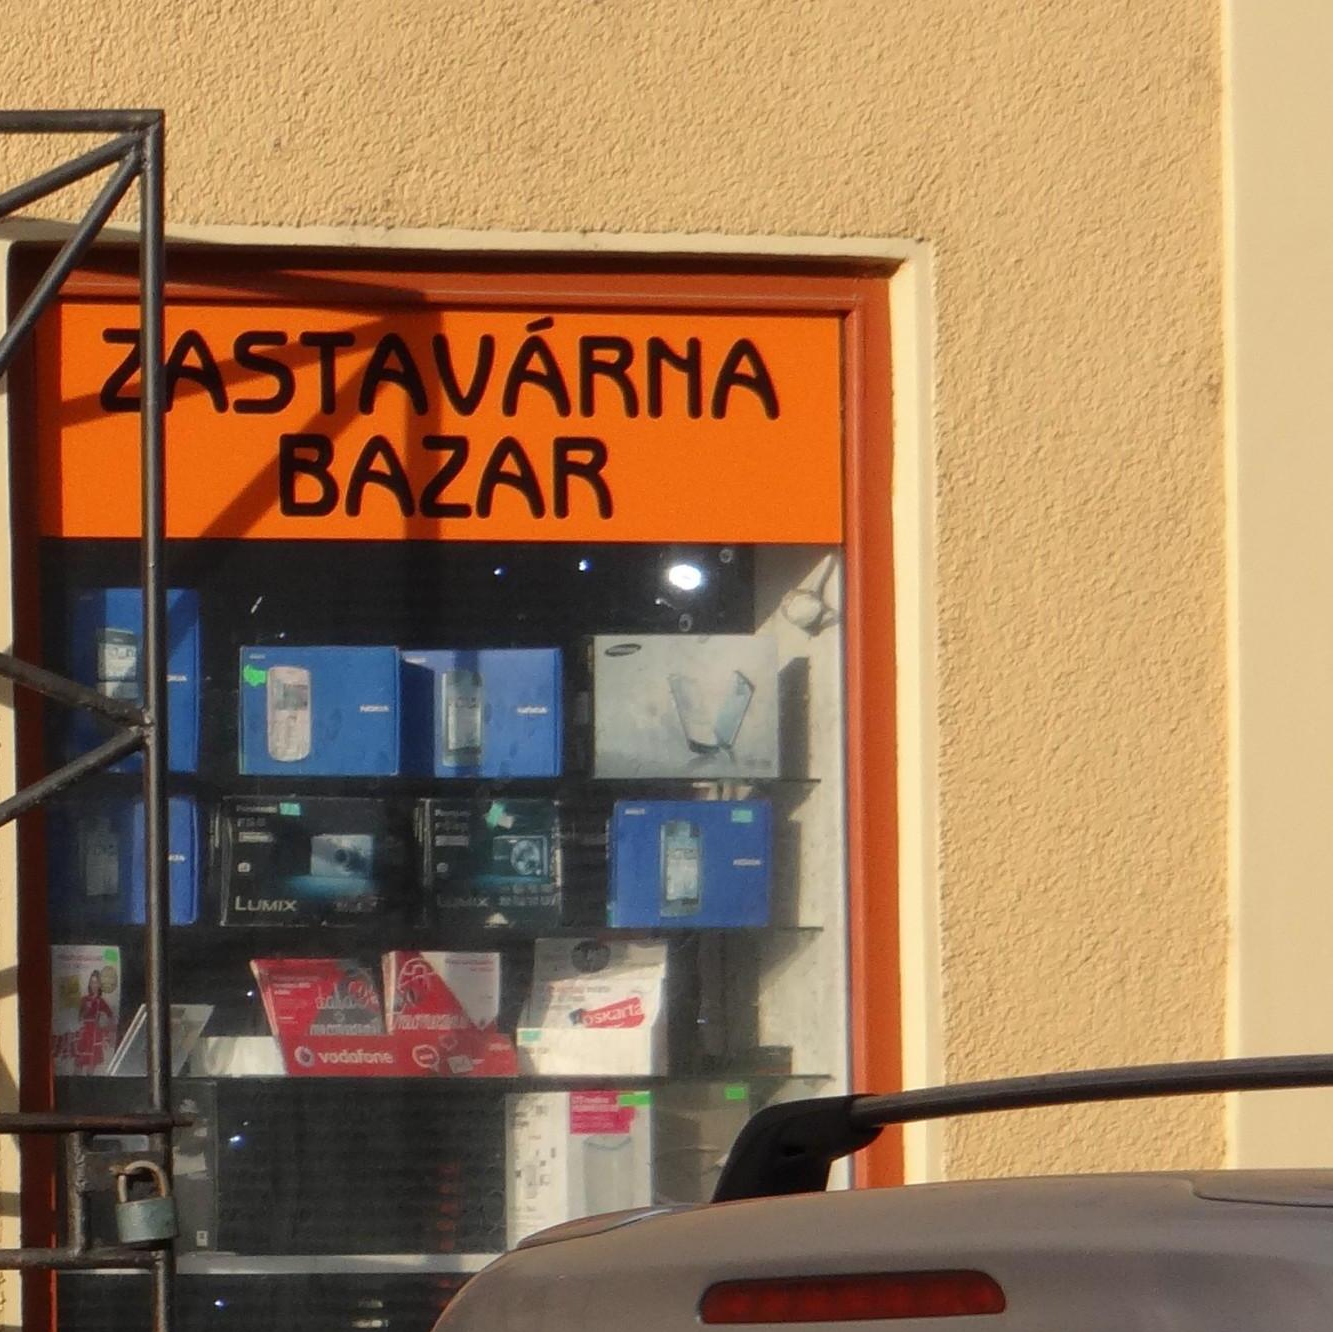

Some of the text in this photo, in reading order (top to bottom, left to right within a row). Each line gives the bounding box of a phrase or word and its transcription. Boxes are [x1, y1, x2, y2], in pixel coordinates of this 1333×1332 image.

[100, 316, 780, 420] ZASTAVÁRNA
[279, 433, 613, 520] BAZAR
[234, 895, 298, 912] LUMIX
[318, 1049, 394, 1065] vodafone
